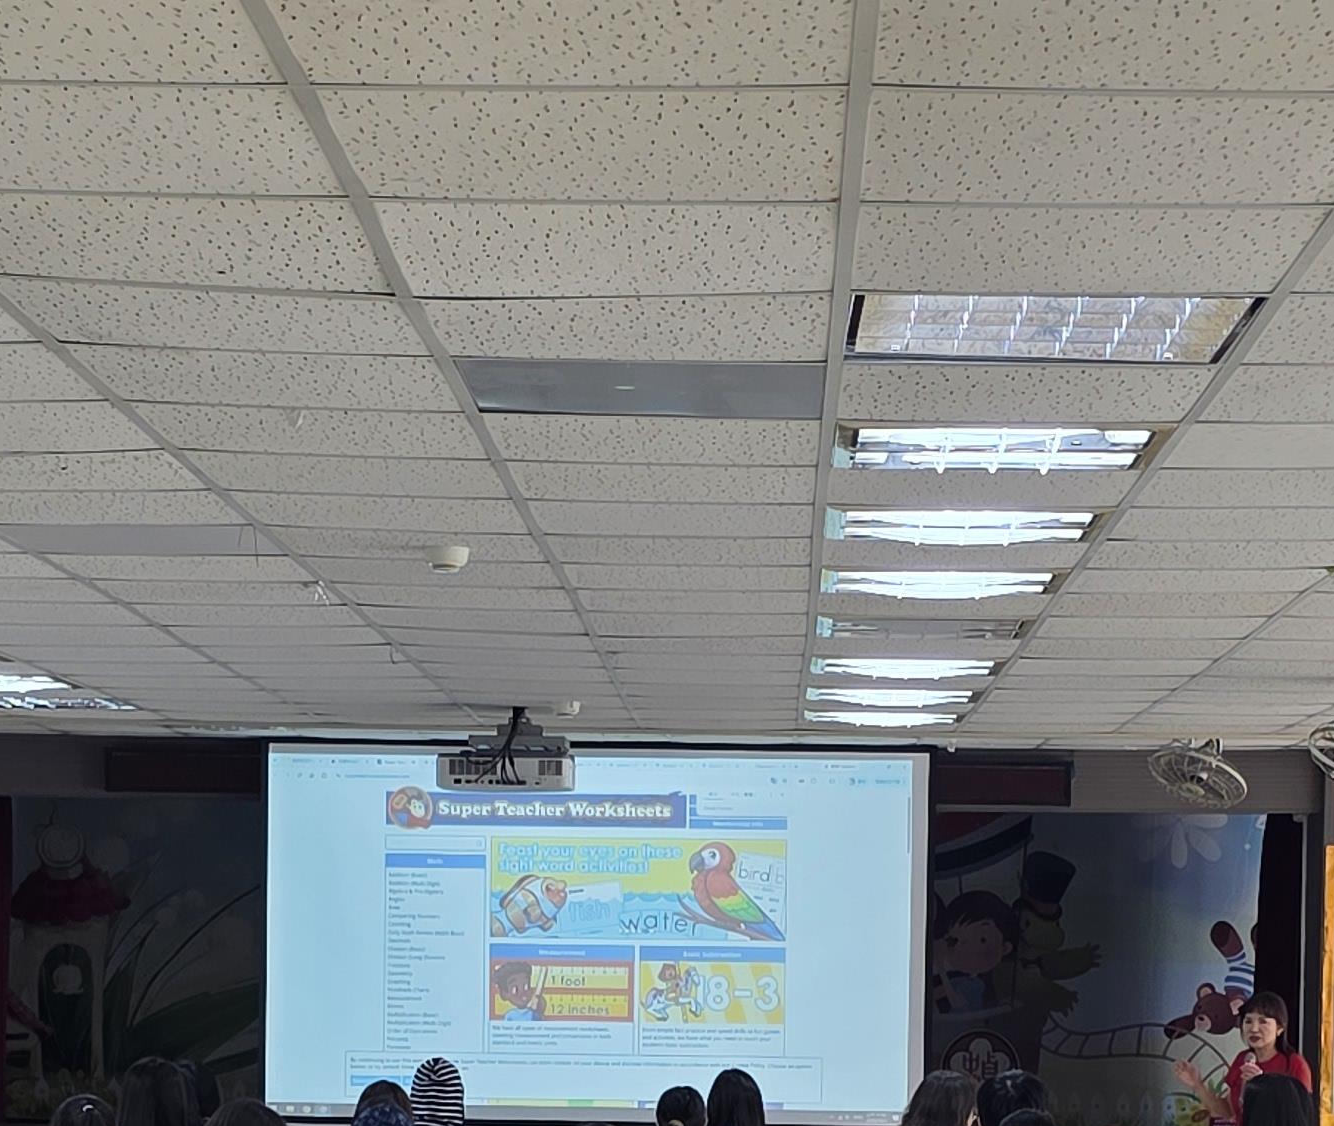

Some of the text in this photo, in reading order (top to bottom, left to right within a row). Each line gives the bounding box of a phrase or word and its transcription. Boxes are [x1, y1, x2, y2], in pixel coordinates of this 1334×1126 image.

[438, 800, 672, 818] Super Teacher Worksheets
[498, 843, 682, 861] Feast your eyes on these
[498, 857, 534, 873] sight
[538, 858, 574, 871] word
[738, 860, 772, 882] bird
[619, 911, 697, 937] water
[560, 976, 587, 987] foot
[551, 1003, 610, 1016] 12 inches
